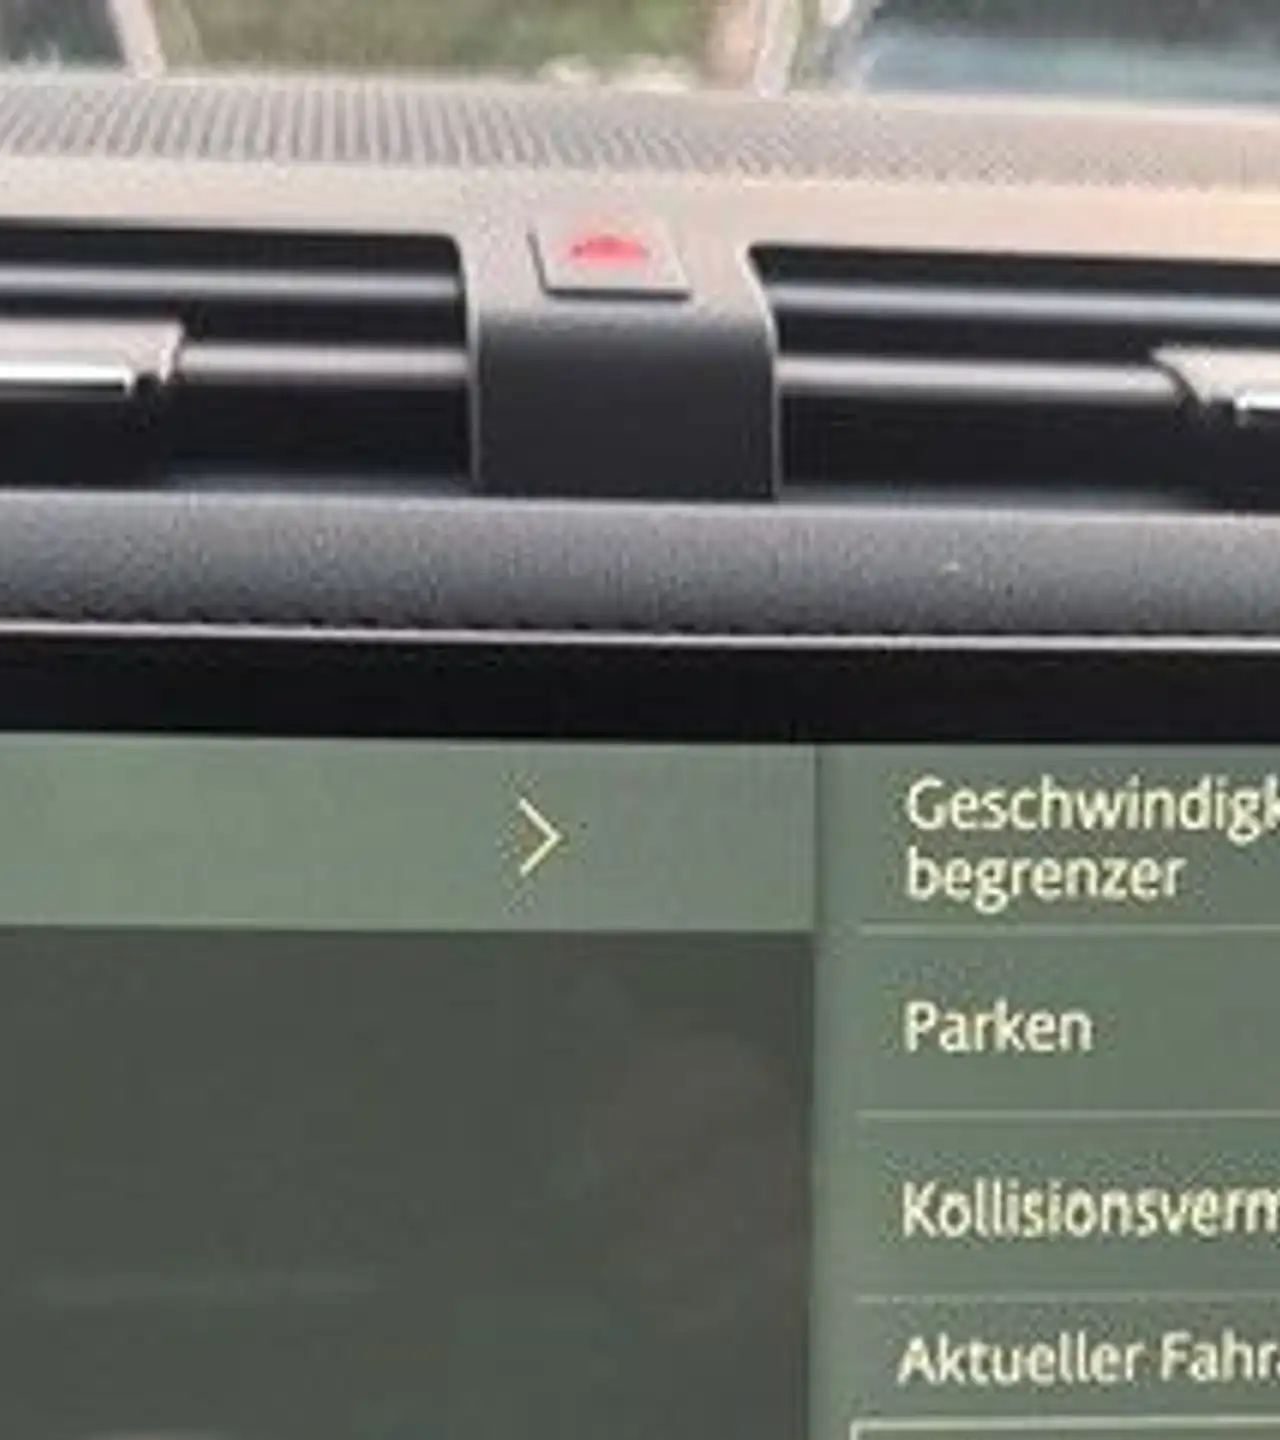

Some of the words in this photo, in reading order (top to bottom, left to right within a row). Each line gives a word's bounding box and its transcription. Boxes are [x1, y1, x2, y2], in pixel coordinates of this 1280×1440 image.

[906, 844, 1187, 915] begrenzer
[903, 998, 1093, 1054] Parken
[896, 1330, 1146, 1386] Aktueller
